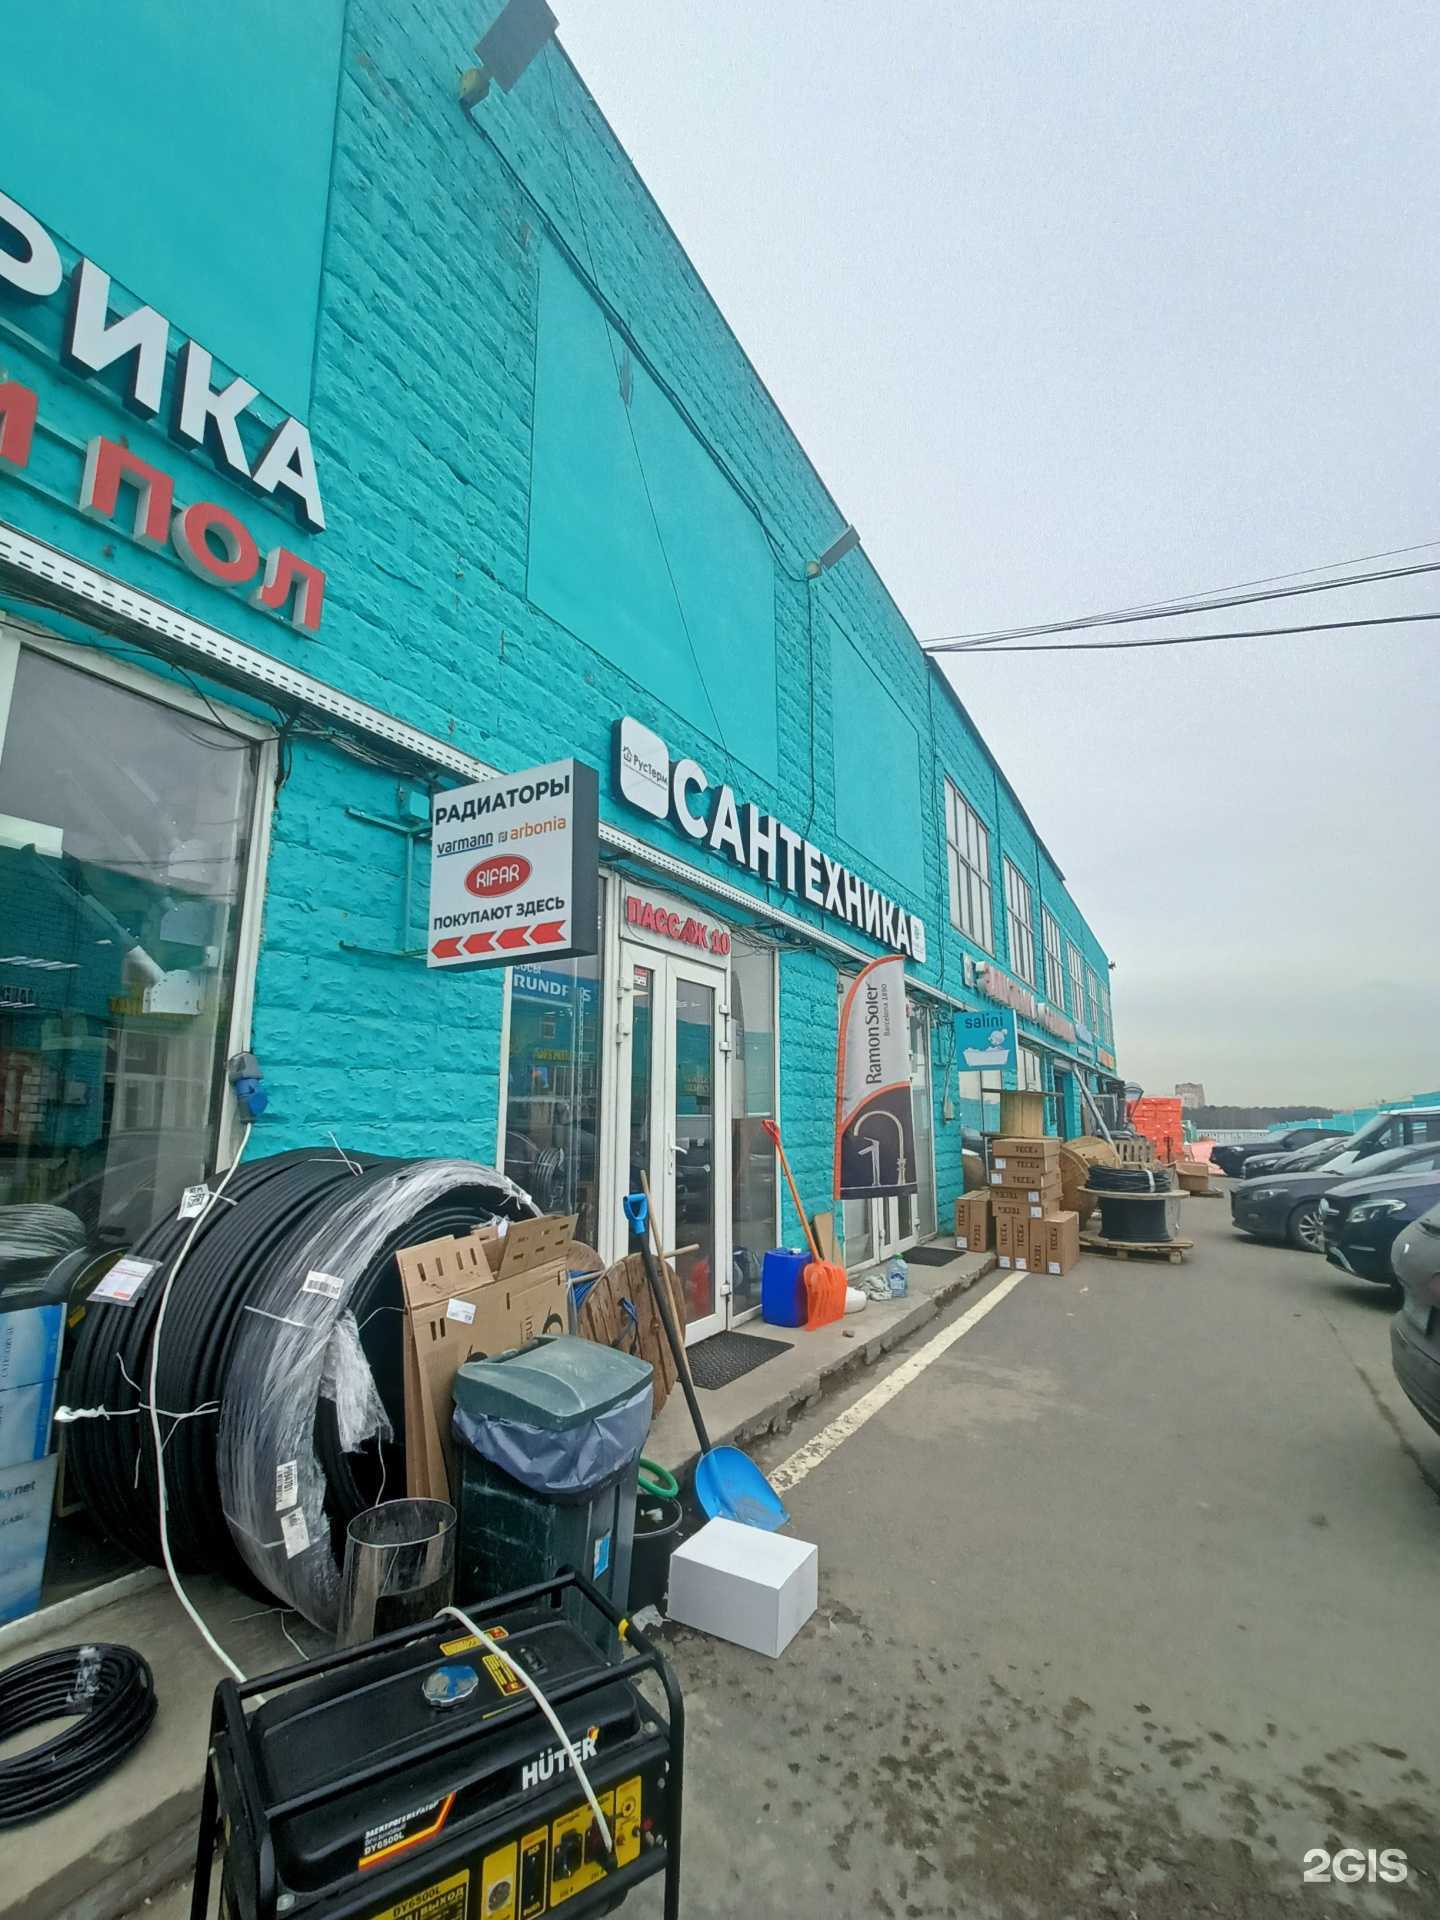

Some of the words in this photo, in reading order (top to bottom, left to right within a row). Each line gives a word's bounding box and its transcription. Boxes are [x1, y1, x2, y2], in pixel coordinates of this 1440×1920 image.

[81, 435, 326, 633] ПОЛ
[435, 775, 570, 825] РАДИАТОРЫ
[436, 832, 494, 857] varmann
[510, 816, 567, 841] arbonia
[475, 864, 520, 889] RIFAR
[673, 758, 912, 957] САНТЕХНИКА
[433, 905, 513, 930] ПОКУПАЮТ
[516, 896, 565, 917] ЗДЕСЬ
[626, 895, 709, 950] ПАССАЖ
[711, 918, 731, 956] 10
[513, 973, 593, 1003] RUNDFS
[964, 1013, 1004, 1029] salini
[521, 1736, 598, 1791] HÜTER
[363, 1831, 405, 1856] DY6500L
